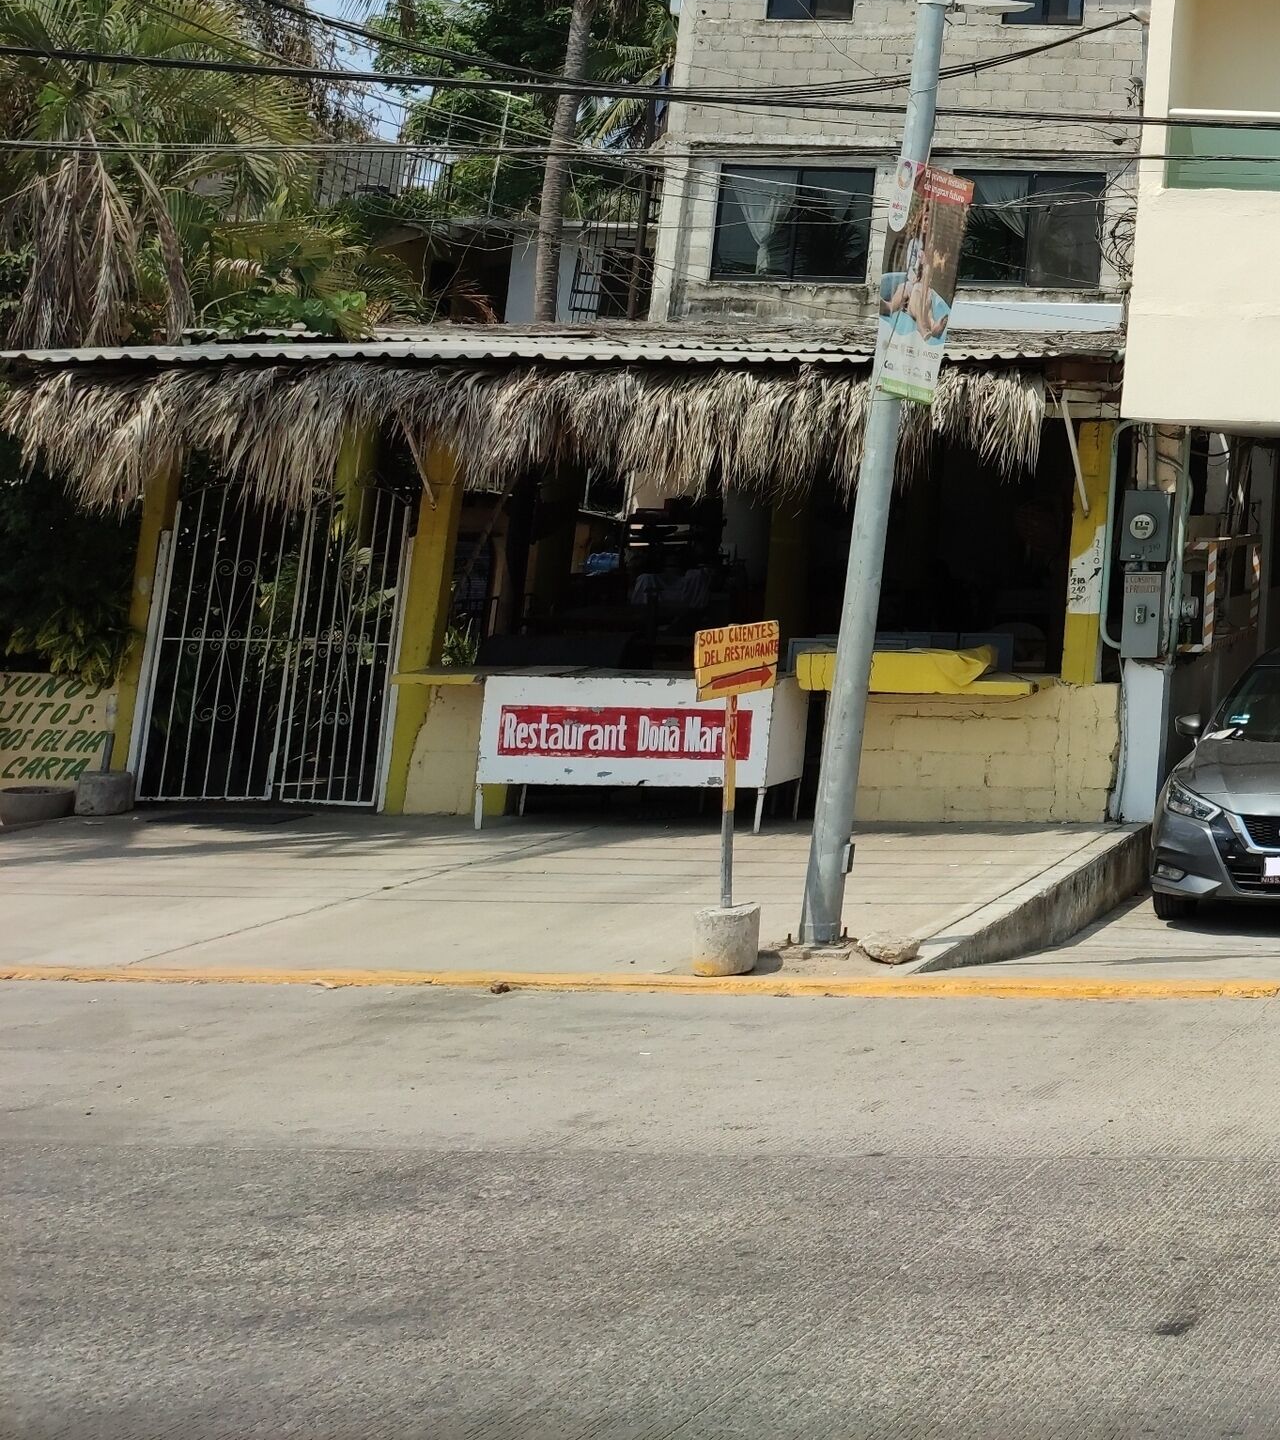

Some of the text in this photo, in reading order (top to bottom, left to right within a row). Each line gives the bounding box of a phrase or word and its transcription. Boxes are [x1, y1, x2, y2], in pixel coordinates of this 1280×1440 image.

[699, 623, 774, 647] SOLO CLIENTES
[704, 639, 779, 666] DEL RESTAURANTE
[31, 729, 68, 752] DEL
[64, 730, 109, 753] DIA
[503, 713, 627, 751] Restaurant
[2, 757, 91, 781] CARTA
